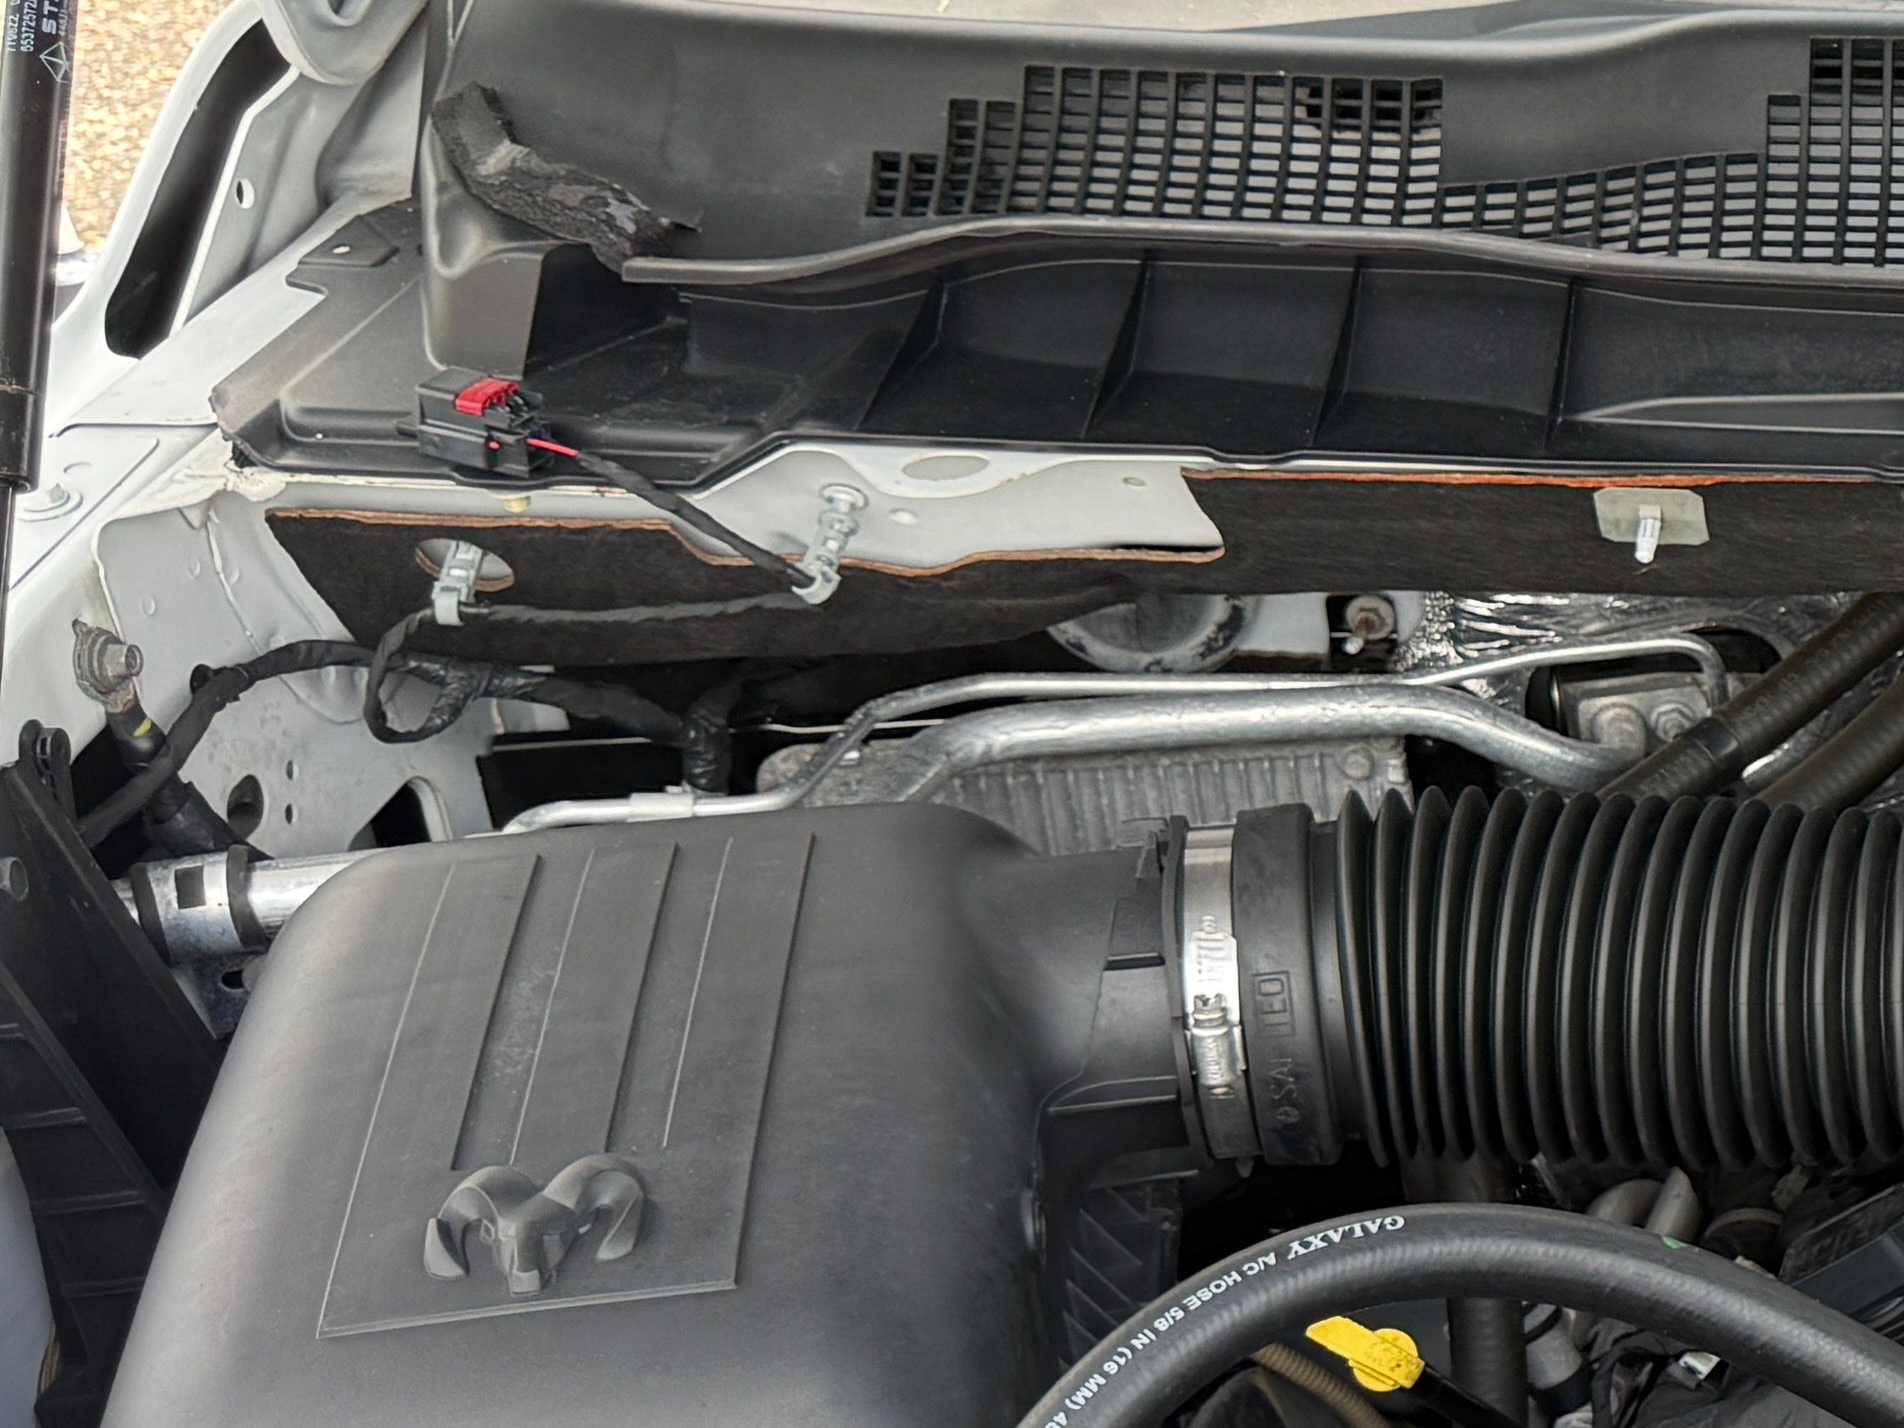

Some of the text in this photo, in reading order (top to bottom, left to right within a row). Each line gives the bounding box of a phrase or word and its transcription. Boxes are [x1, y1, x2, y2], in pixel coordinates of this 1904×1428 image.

[1286, 1215, 1405, 1261] GALAXY
[1242, 1251, 1277, 1277] A/C
[1181, 1270, 1243, 1311] HOSE
[1153, 1304, 1185, 1332] 5/8
[1130, 1326, 1157, 1350] IN
[1102, 1347, 1133, 1376] (16
[1064, 1373, 1107, 1410] MM)
